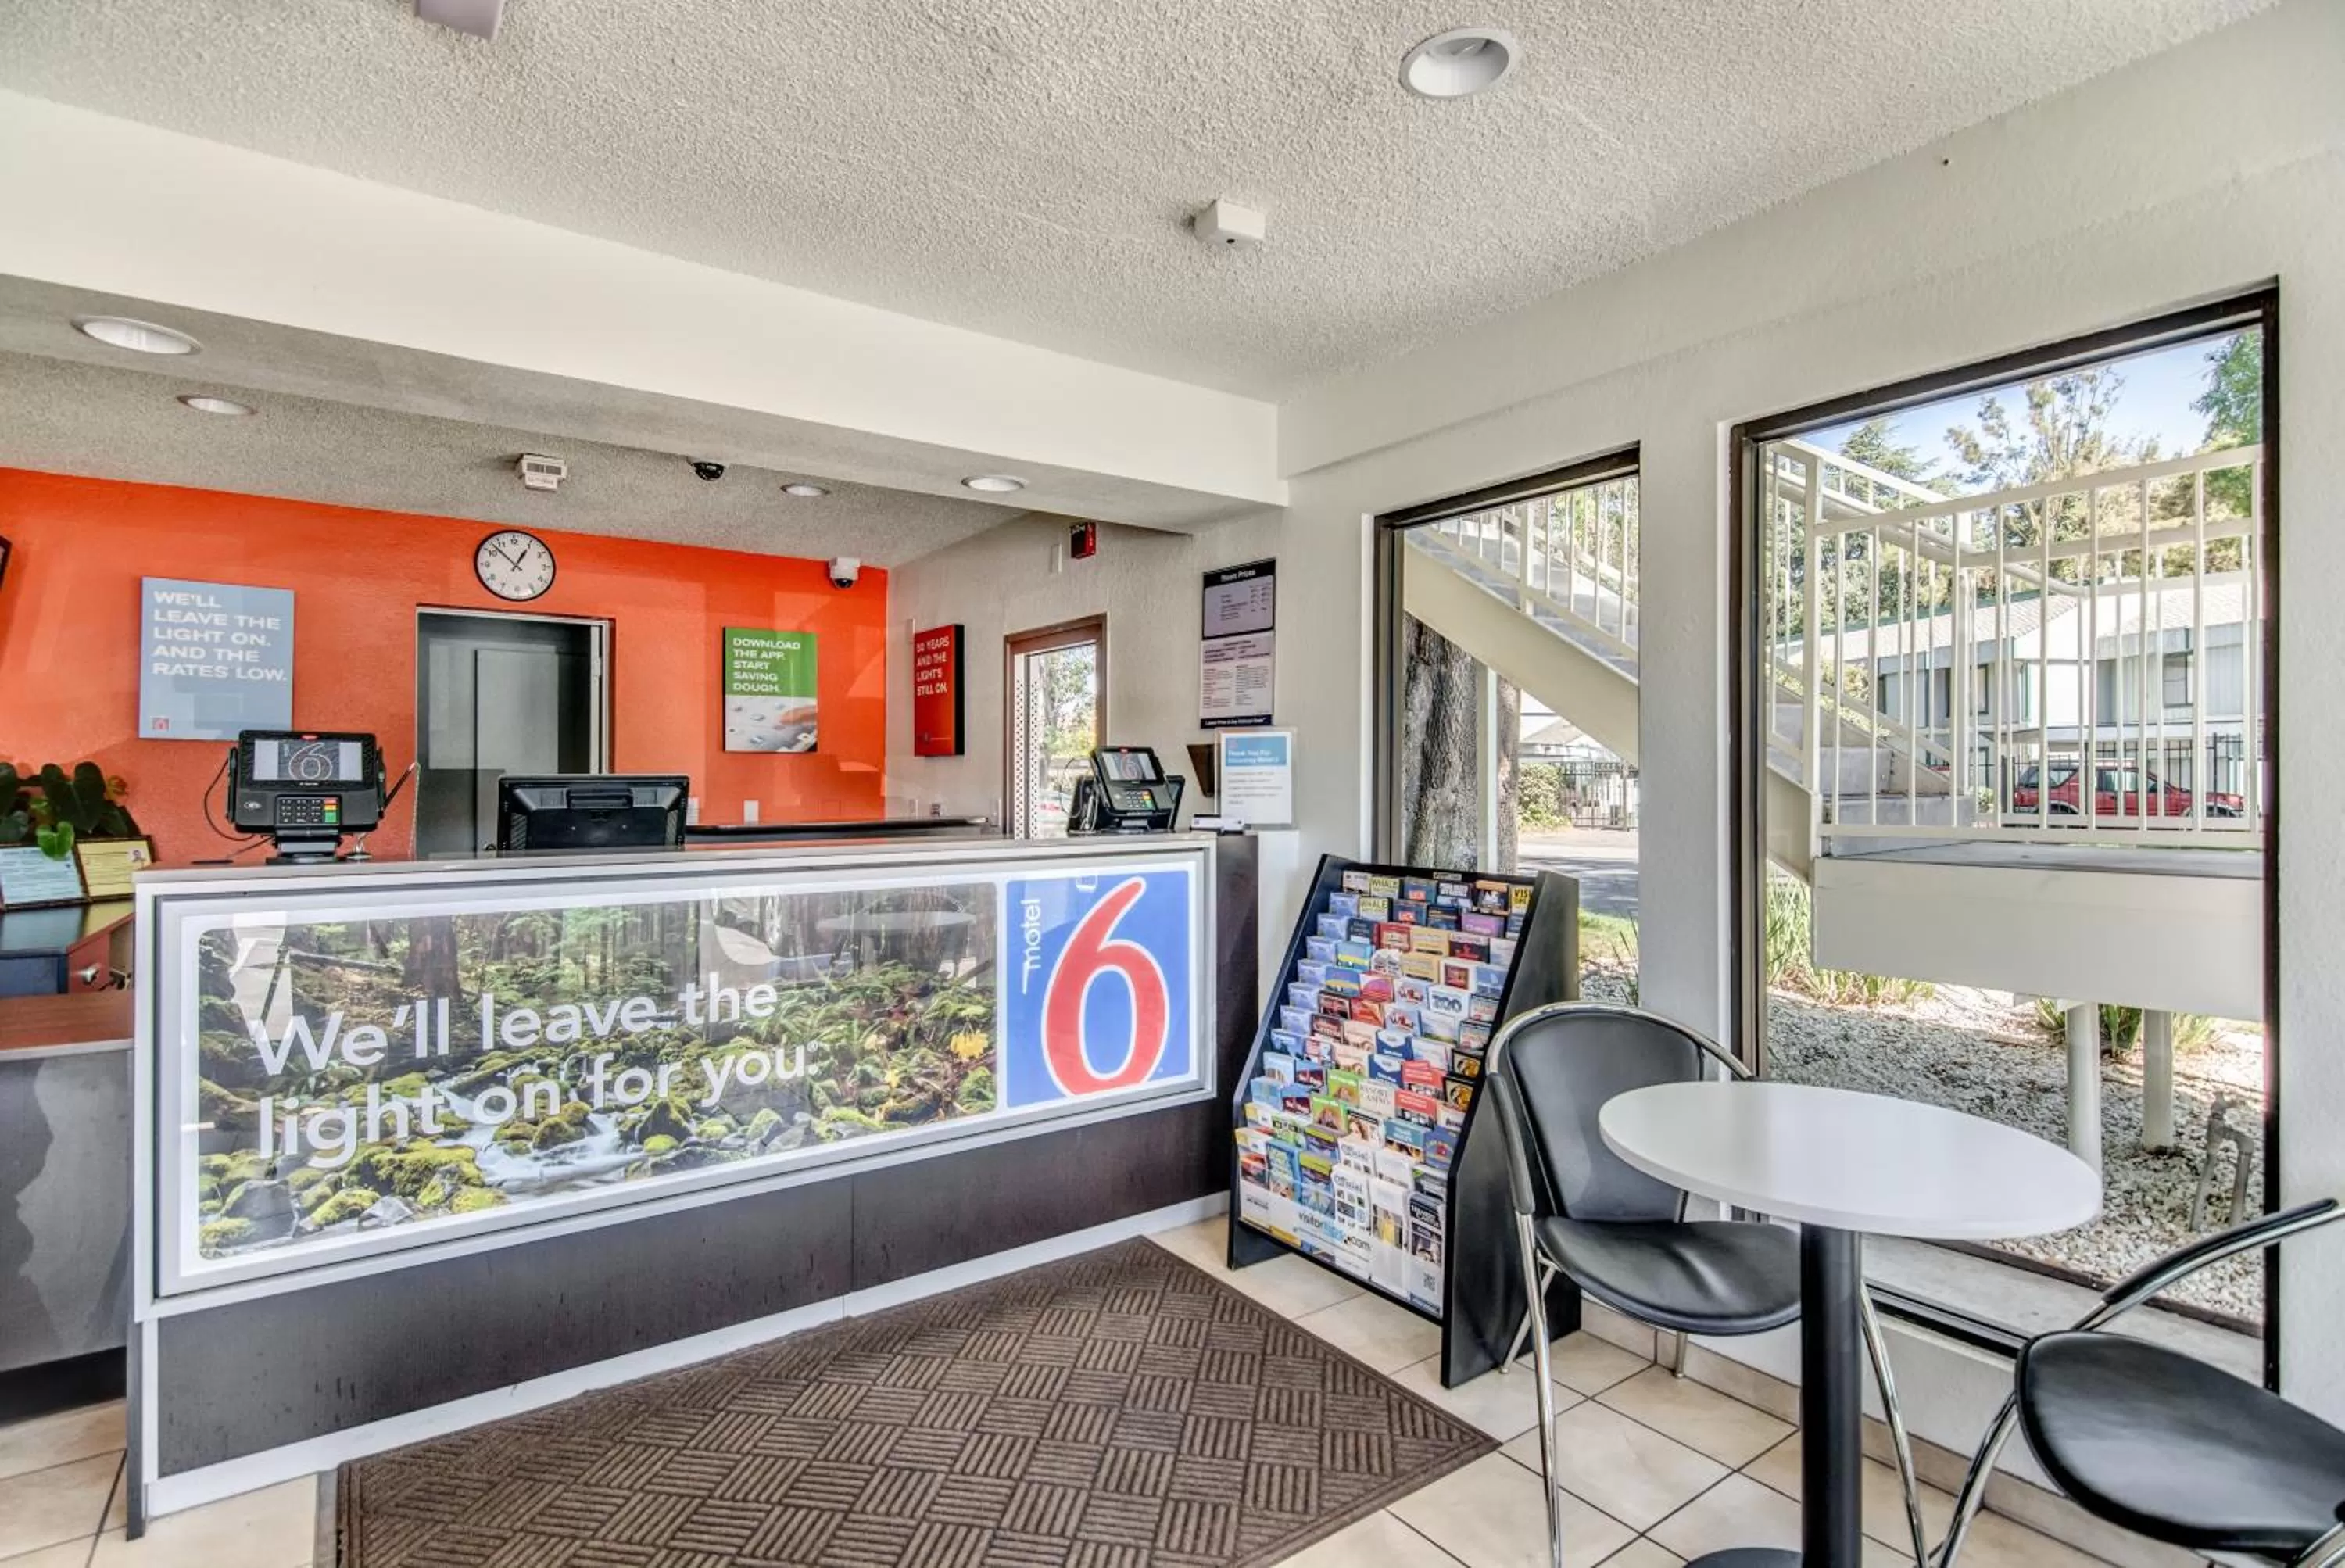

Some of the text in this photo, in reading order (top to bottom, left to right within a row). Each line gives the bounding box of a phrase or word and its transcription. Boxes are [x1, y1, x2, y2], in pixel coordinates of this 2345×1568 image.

[152, 590, 223, 608] WE'LL
[153, 609, 282, 630] LEAVE THE
[153, 628, 272, 646] LIGHT ON.
[732, 637, 801, 650] DOWNLOAD
[926, 635, 950, 651] YEARS
[152, 644, 260, 662] AND THE
[733, 649, 757, 658] THE
[917, 651, 947, 667] AND THE
[152, 662, 288, 682] RATES LOW.
[733, 660, 771, 670] START
[732, 671, 779, 682] SAVING
[917, 684, 934, 697] STILL
[288, 742, 334, 780] 6
[1361, 899, 1387, 908] WHALE
[1020, 876, 1170, 1097] motel 6
[246, 972, 779, 1076] We'll leave the
[258, 1083, 445, 1169] light
[472, 1076, 560, 1126] on
[585, 1052, 682, 1110] for
